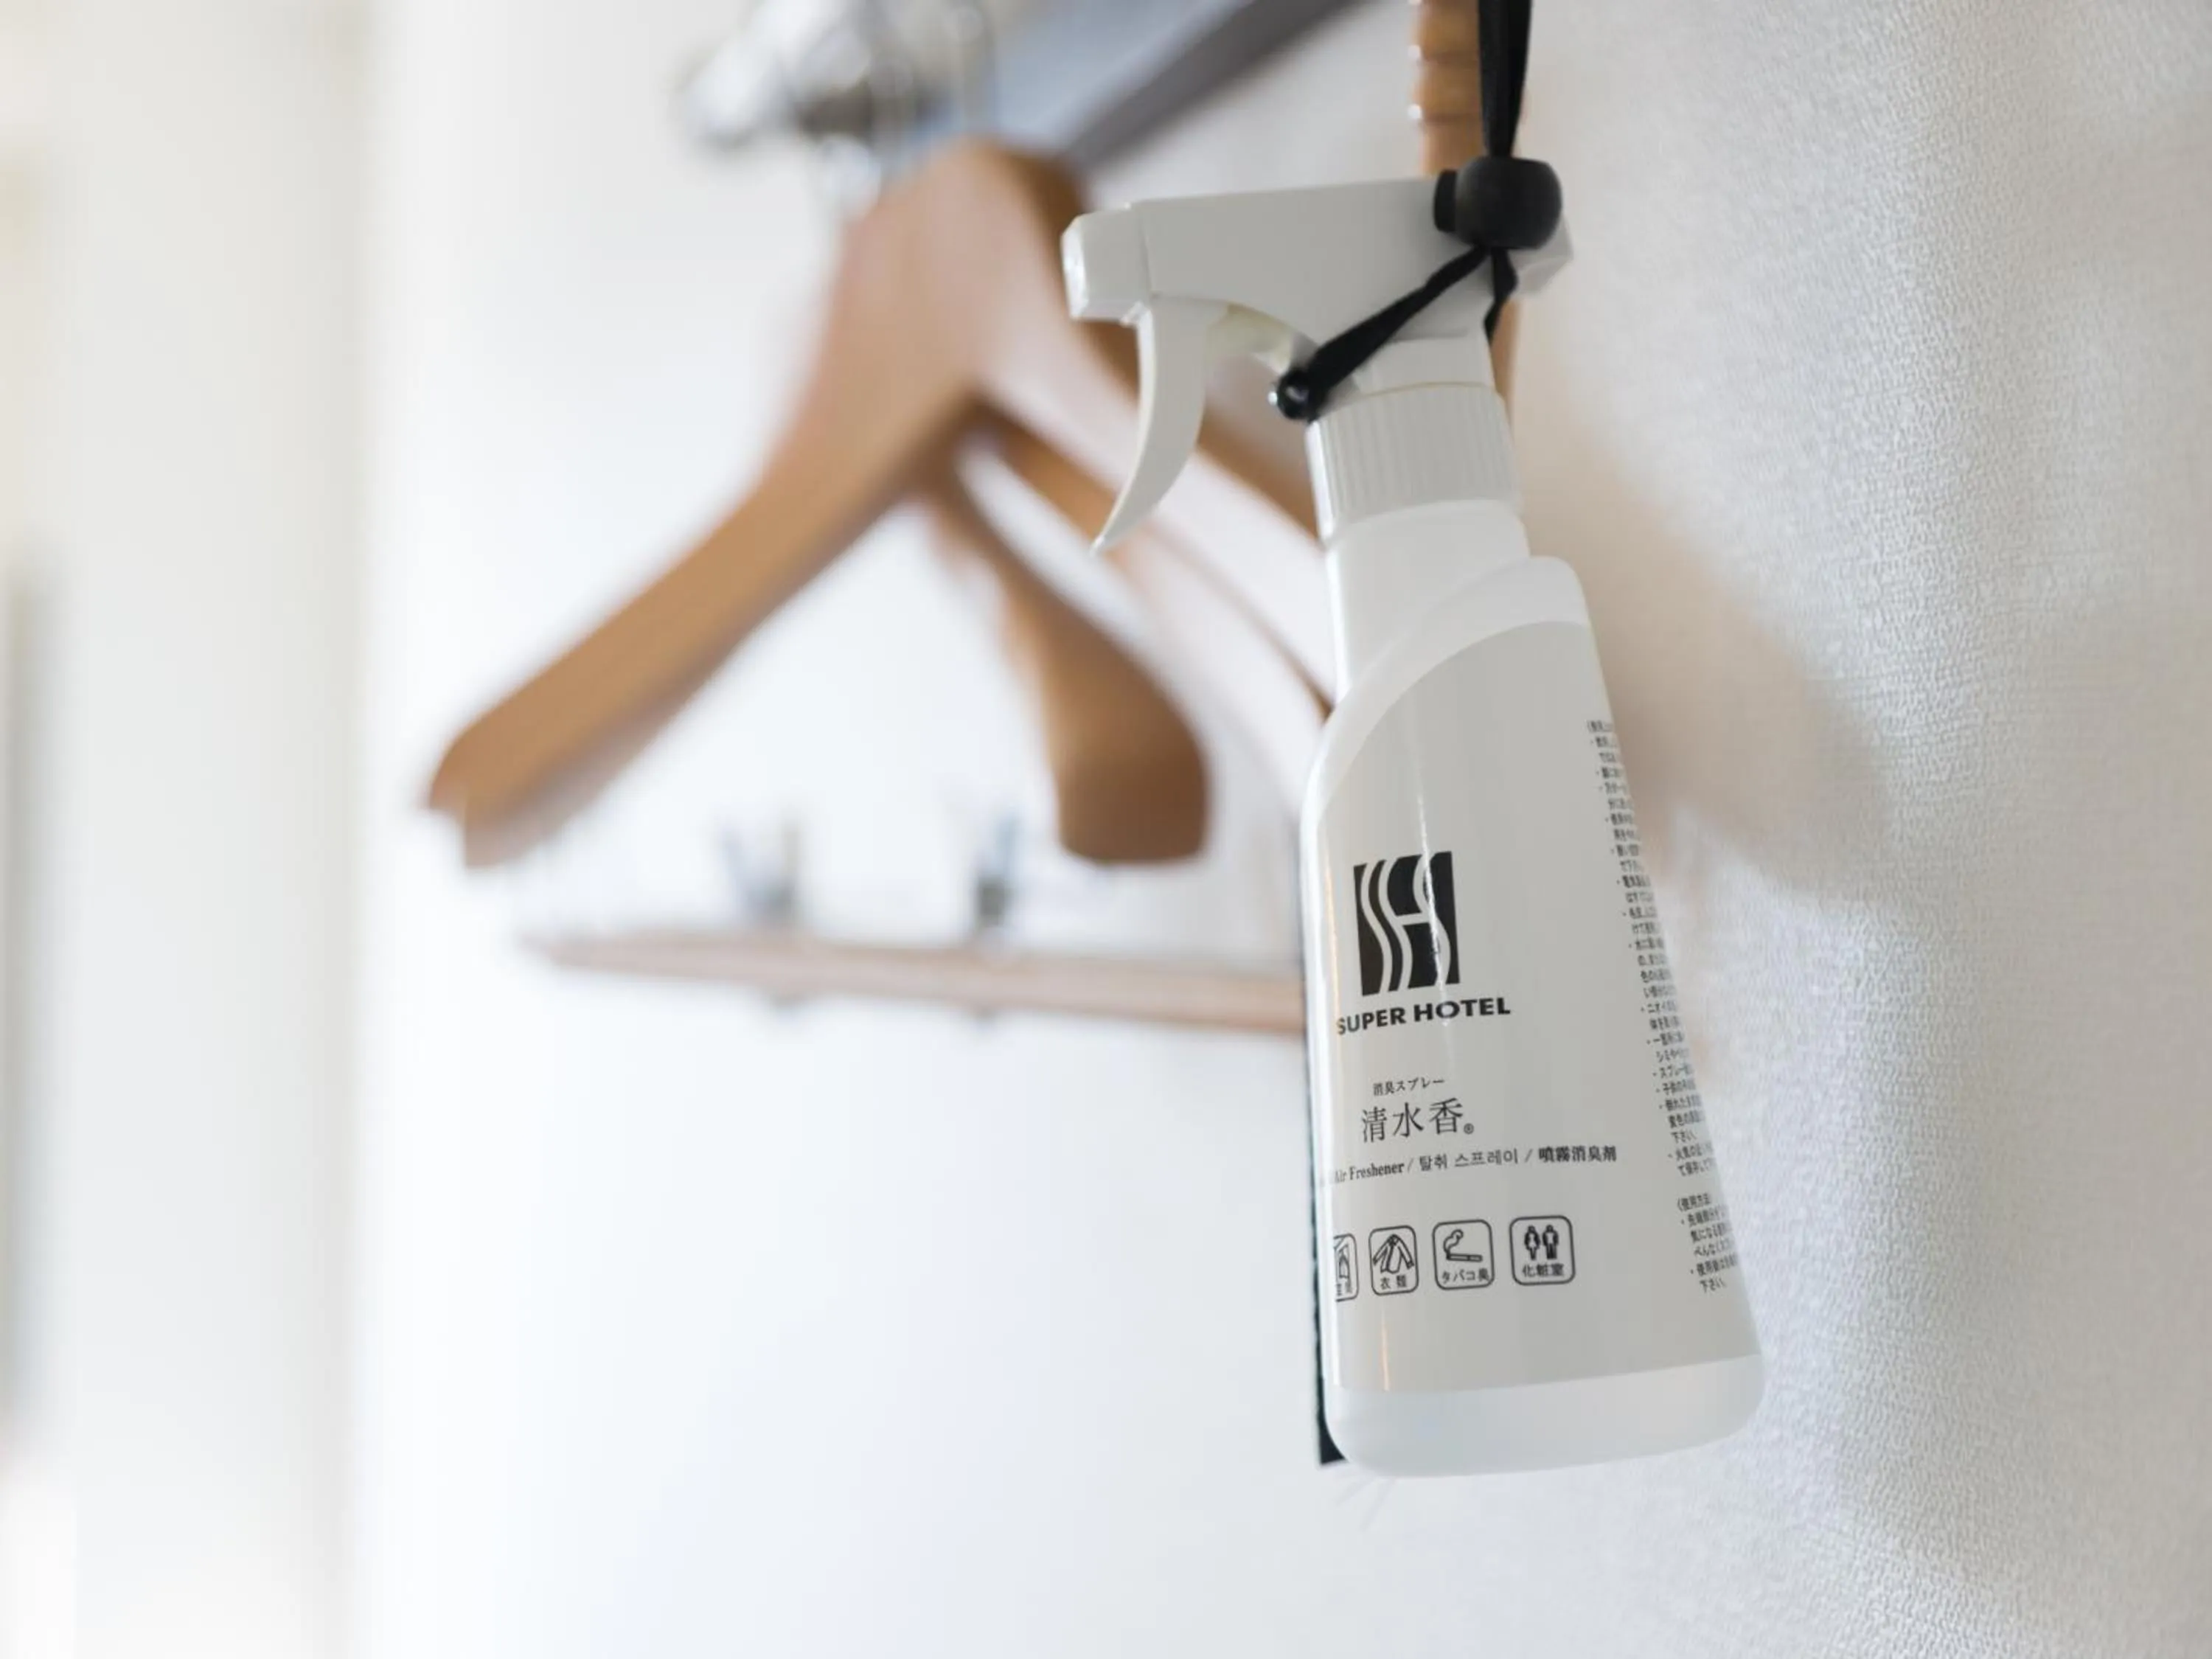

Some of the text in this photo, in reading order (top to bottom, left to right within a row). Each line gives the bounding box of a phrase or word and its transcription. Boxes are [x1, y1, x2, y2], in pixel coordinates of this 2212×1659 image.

[1337, 998, 1511, 1035] SUPER HOTEL
[1373, 1077, 1445, 1096] 消臭スプレー
[1349, 1162, 1405, 1180] Freshener
[1419, 1154, 1447, 1171] 탈취
[1454, 1148, 1518, 1167] 스프레이
[1441, 1268, 1489, 1283] タバコ臭
[1522, 1264, 1565, 1278] 化粧室
